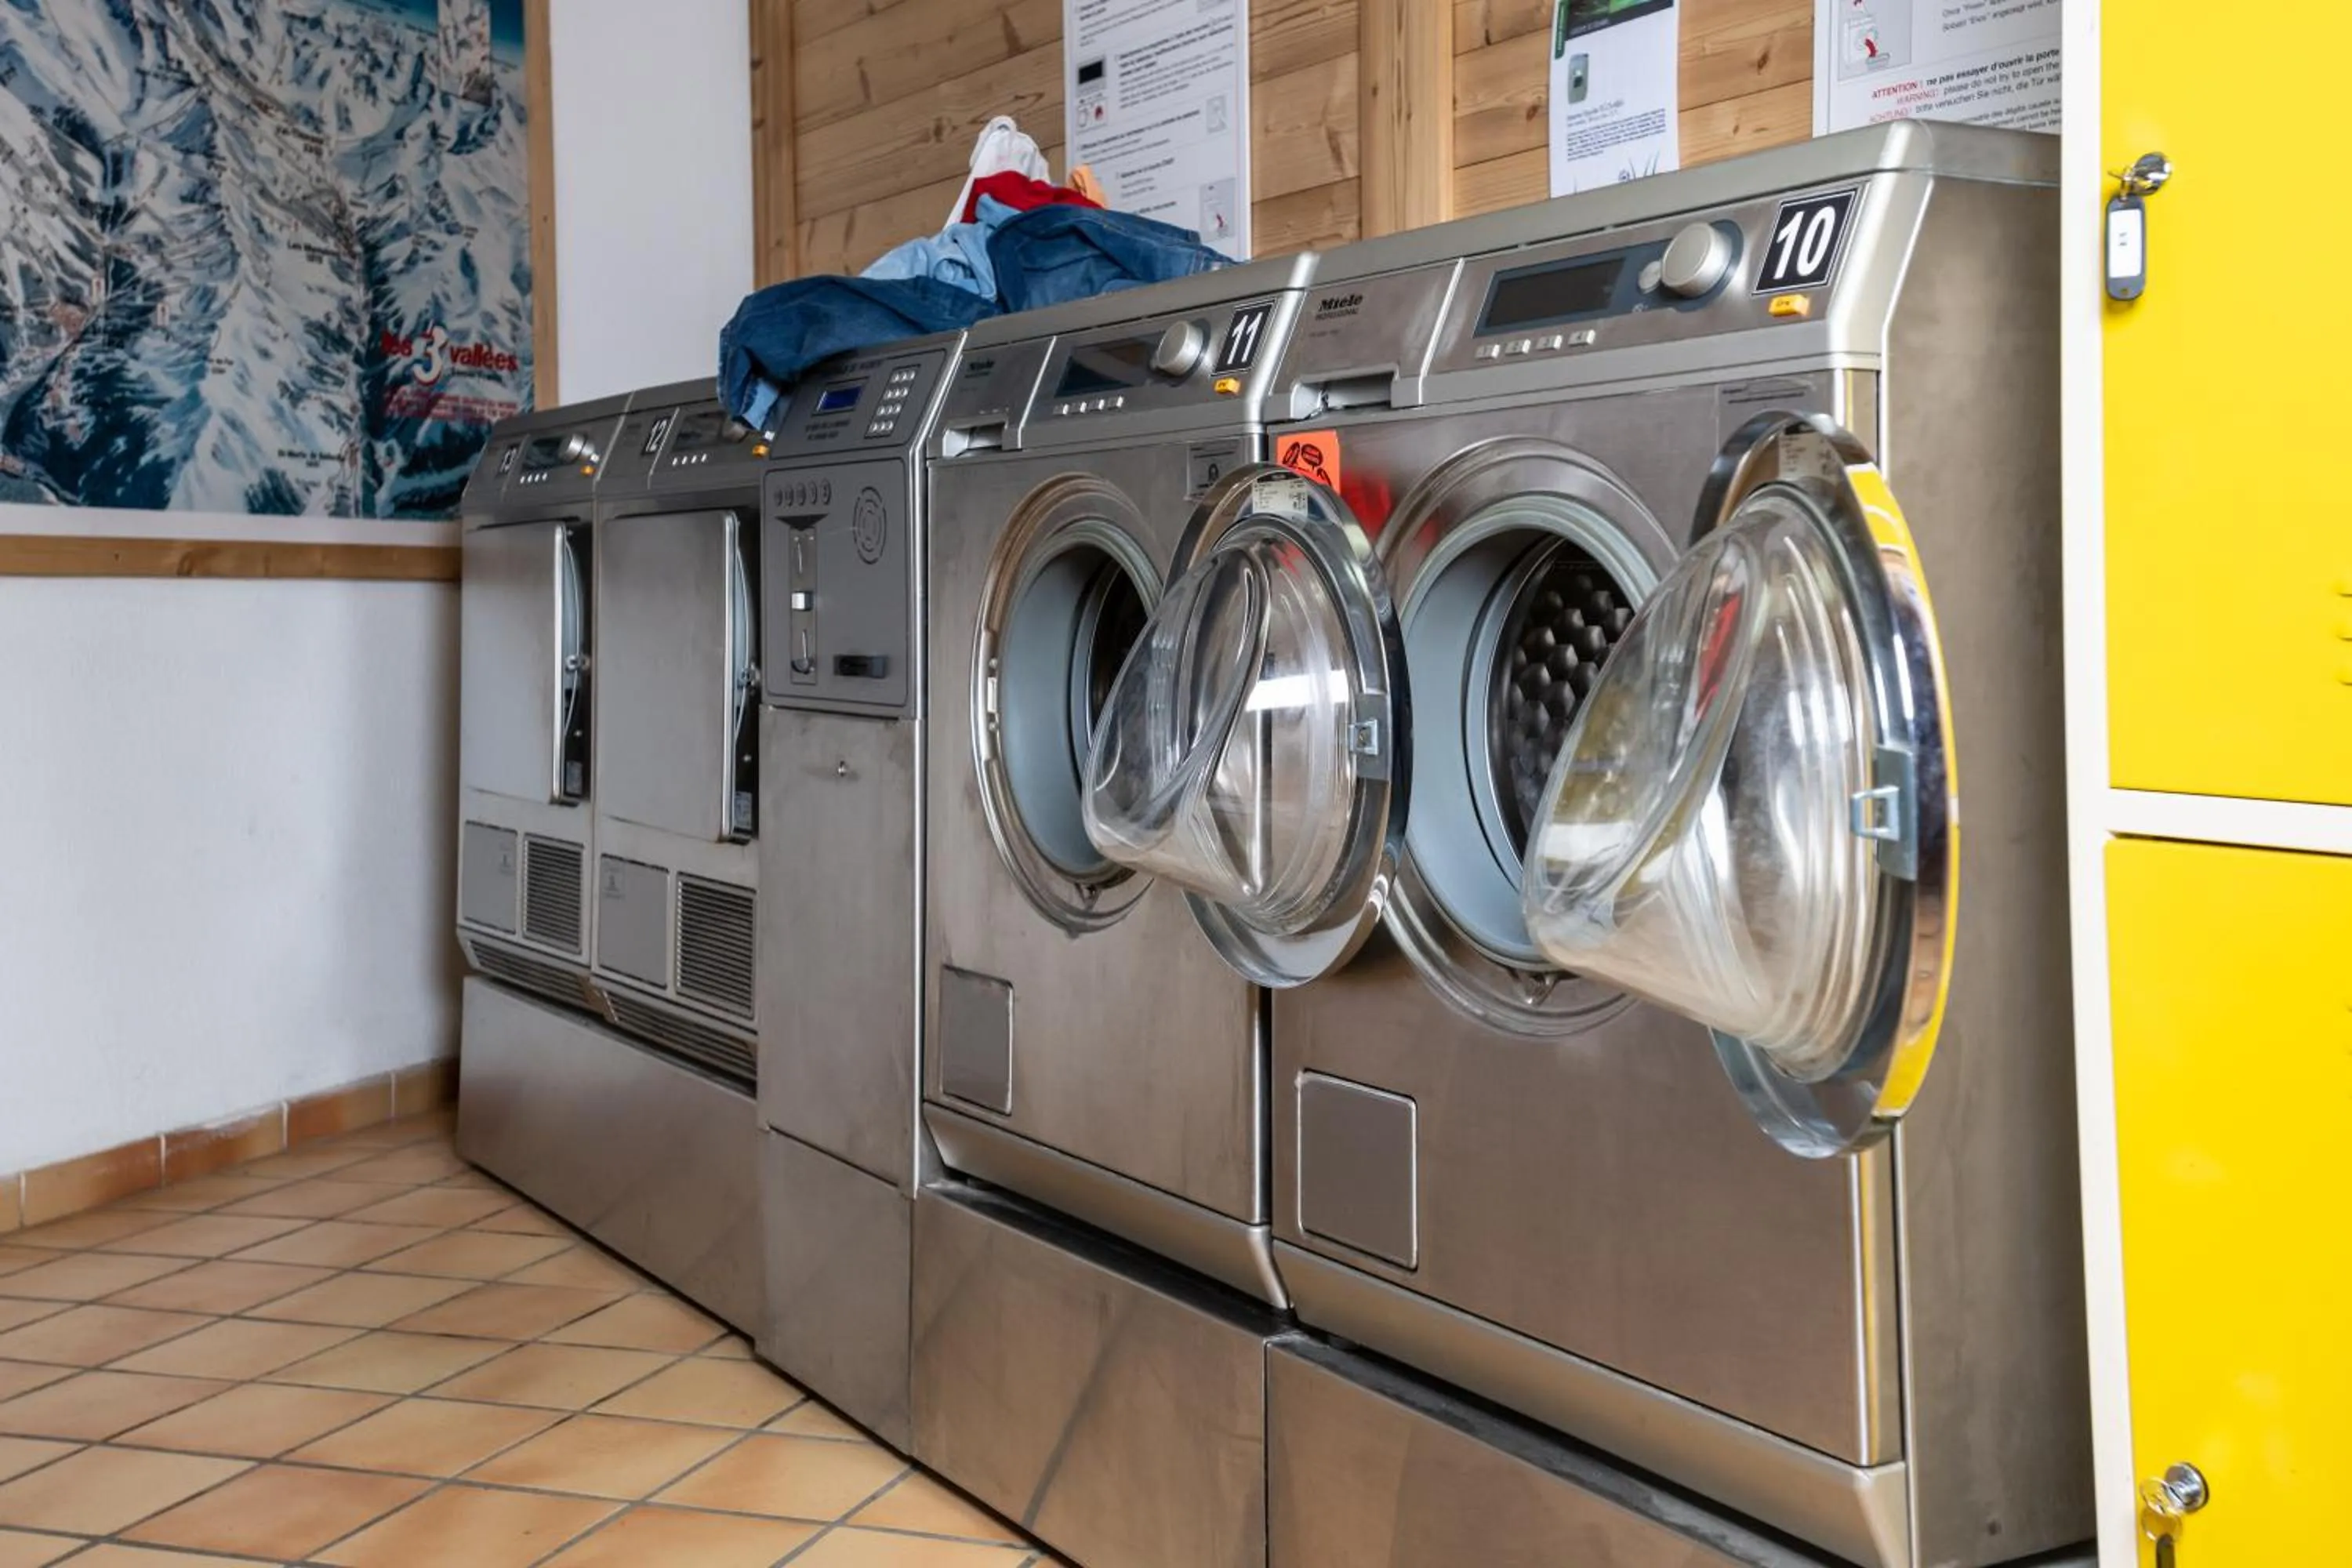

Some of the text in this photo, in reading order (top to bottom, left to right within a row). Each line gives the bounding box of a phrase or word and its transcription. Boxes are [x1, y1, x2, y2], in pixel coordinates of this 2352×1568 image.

[1872, 80, 1918, 99] ATTENTION
[1939, 74, 1955, 85] pas
[1956, 65, 1988, 80] essayer
[2036, 49, 2060, 63] porte
[1773, 205, 1836, 280] 10
[1318, 294, 1363, 312] Miele
[379, 331, 412, 357] les
[412, 325, 449, 387] 3
[450, 342, 519, 372] vallées
[1228, 312, 1263, 365] 11
[645, 419, 666, 452] 12
